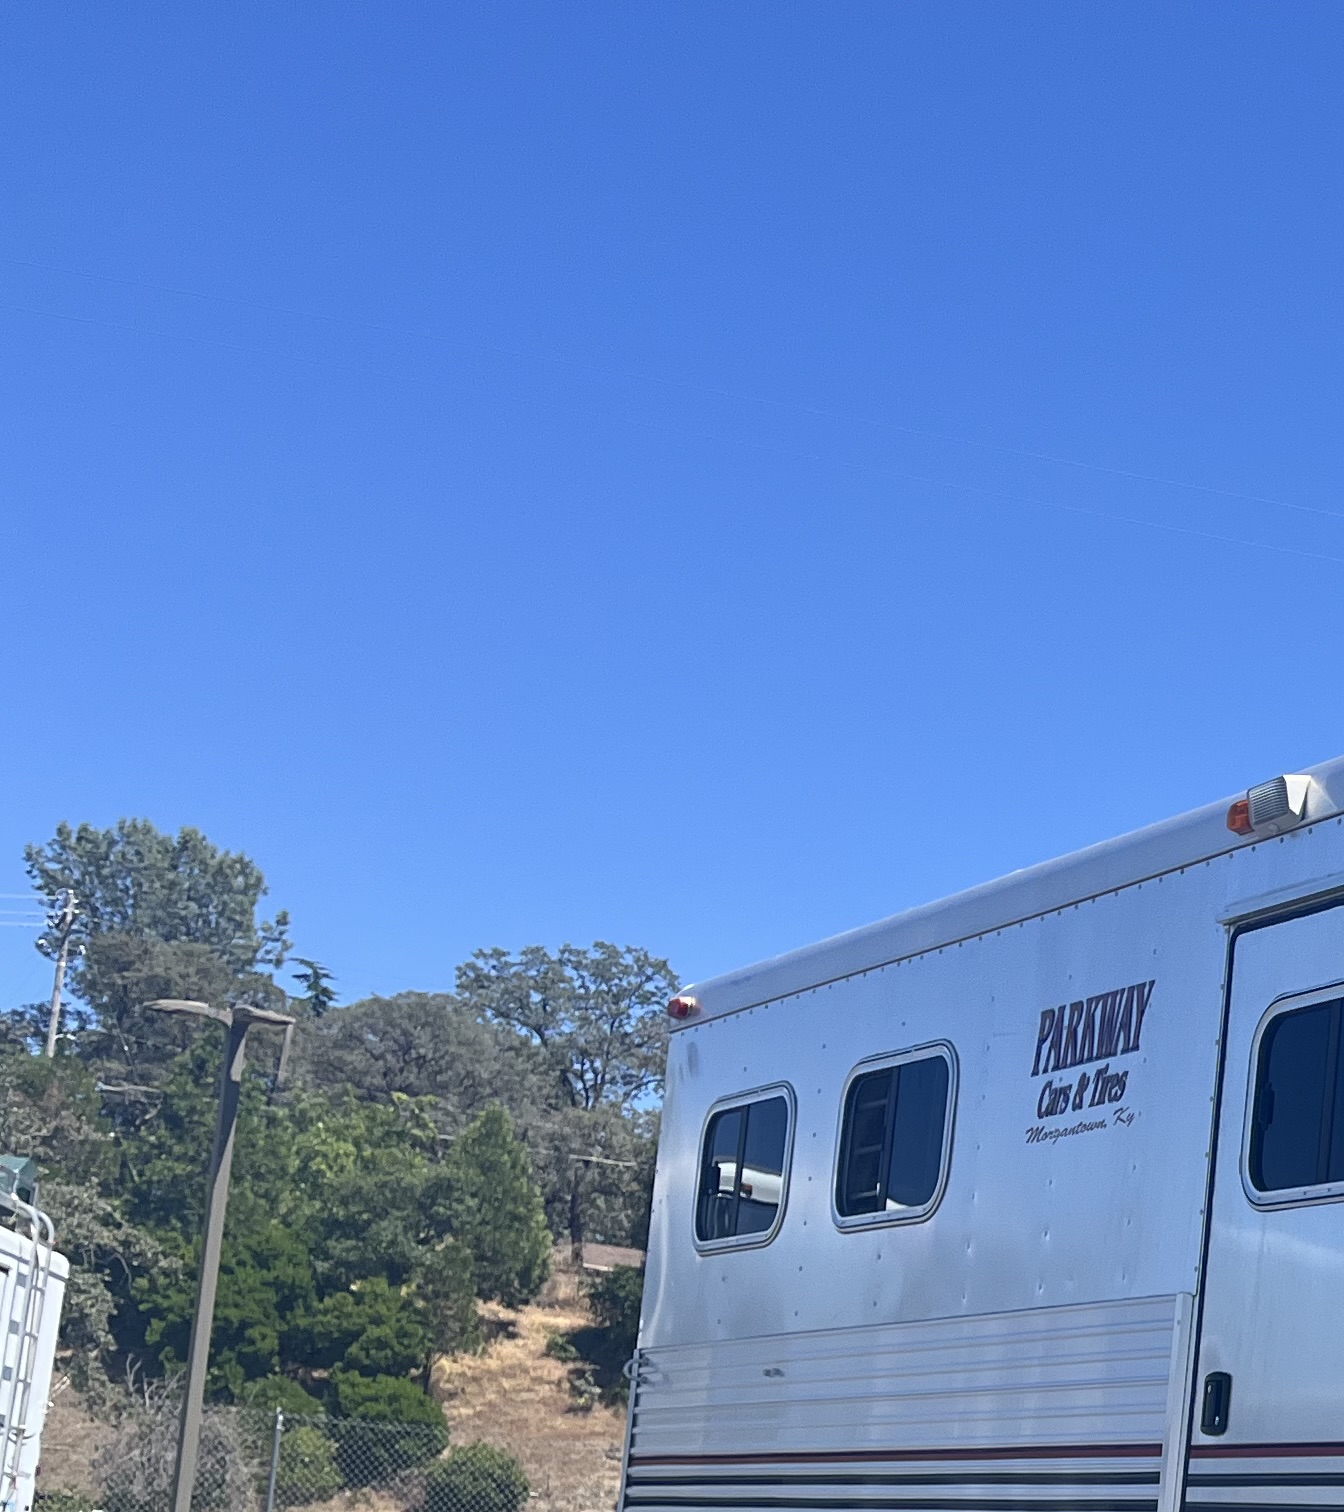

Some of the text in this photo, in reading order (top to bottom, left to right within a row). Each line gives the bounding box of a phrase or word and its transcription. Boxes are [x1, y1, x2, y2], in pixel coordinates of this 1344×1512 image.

[1031, 979, 1156, 1077] PARKWAY
[1037, 1063, 1130, 1120] Cars & Tires
[1113, 1106, 1136, 1129] Ky
